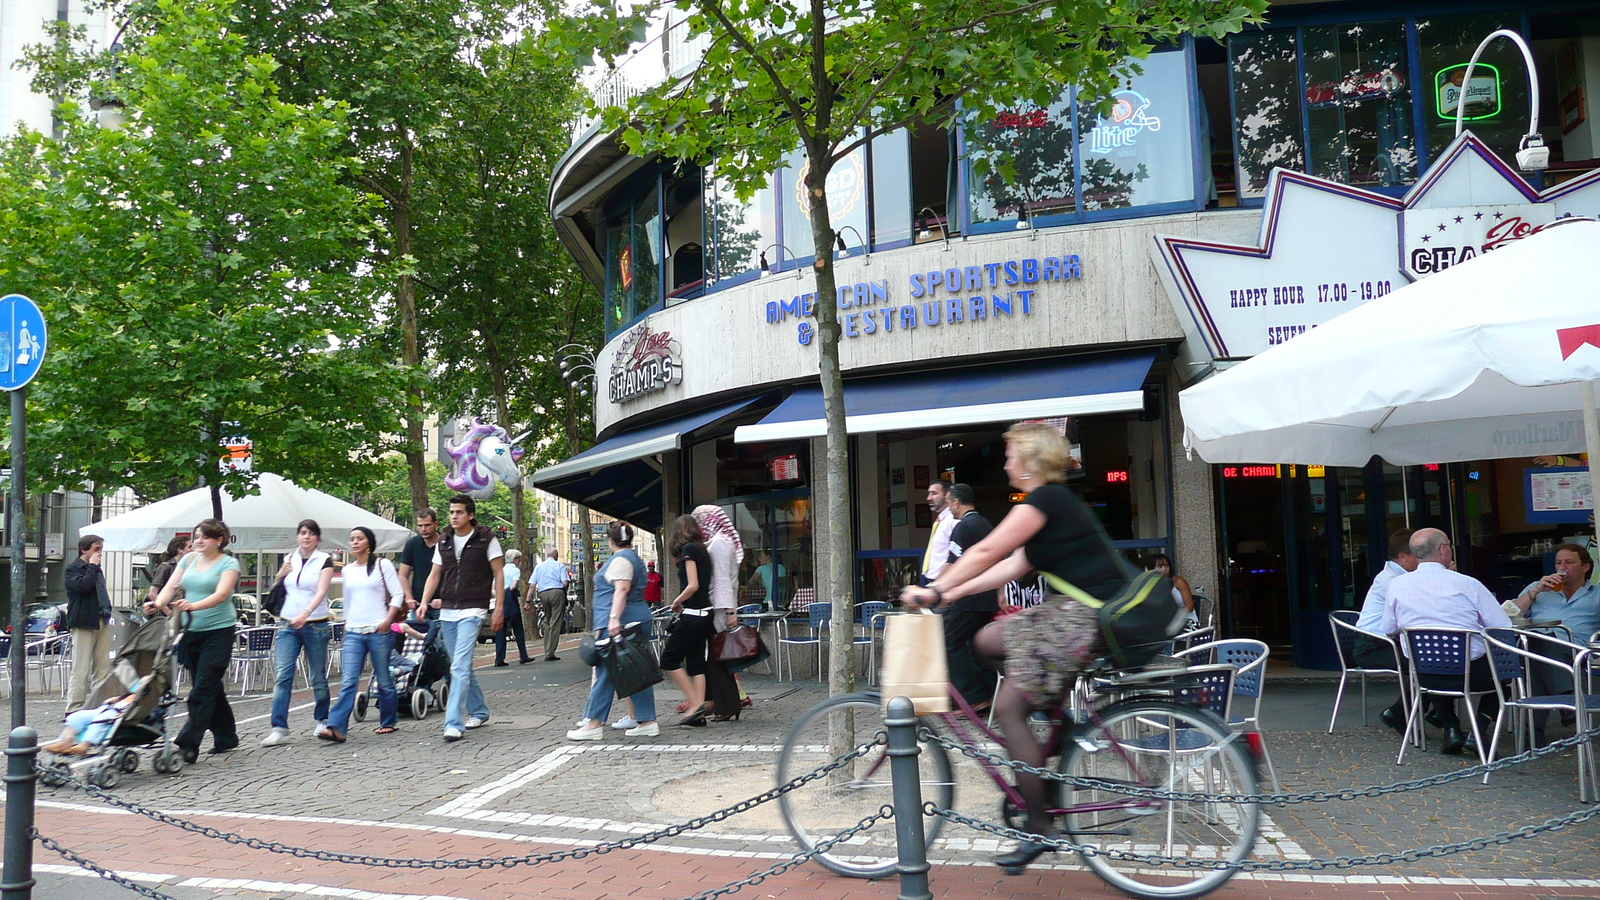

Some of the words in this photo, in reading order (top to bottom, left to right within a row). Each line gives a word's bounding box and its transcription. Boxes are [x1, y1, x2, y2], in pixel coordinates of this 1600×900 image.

[1090, 126, 1138, 154] Lite
[766, 278, 888, 323] AMECAN
[910, 254, 1081, 298] SPORTSBAR
[1230, 288, 1267, 308] HAPPY
[1273, 285, 1305, 306] HOUR
[798, 322, 813, 346] &
[838, 289, 1035, 338] ESTAURANT
[632, 329, 672, 364] Joe
